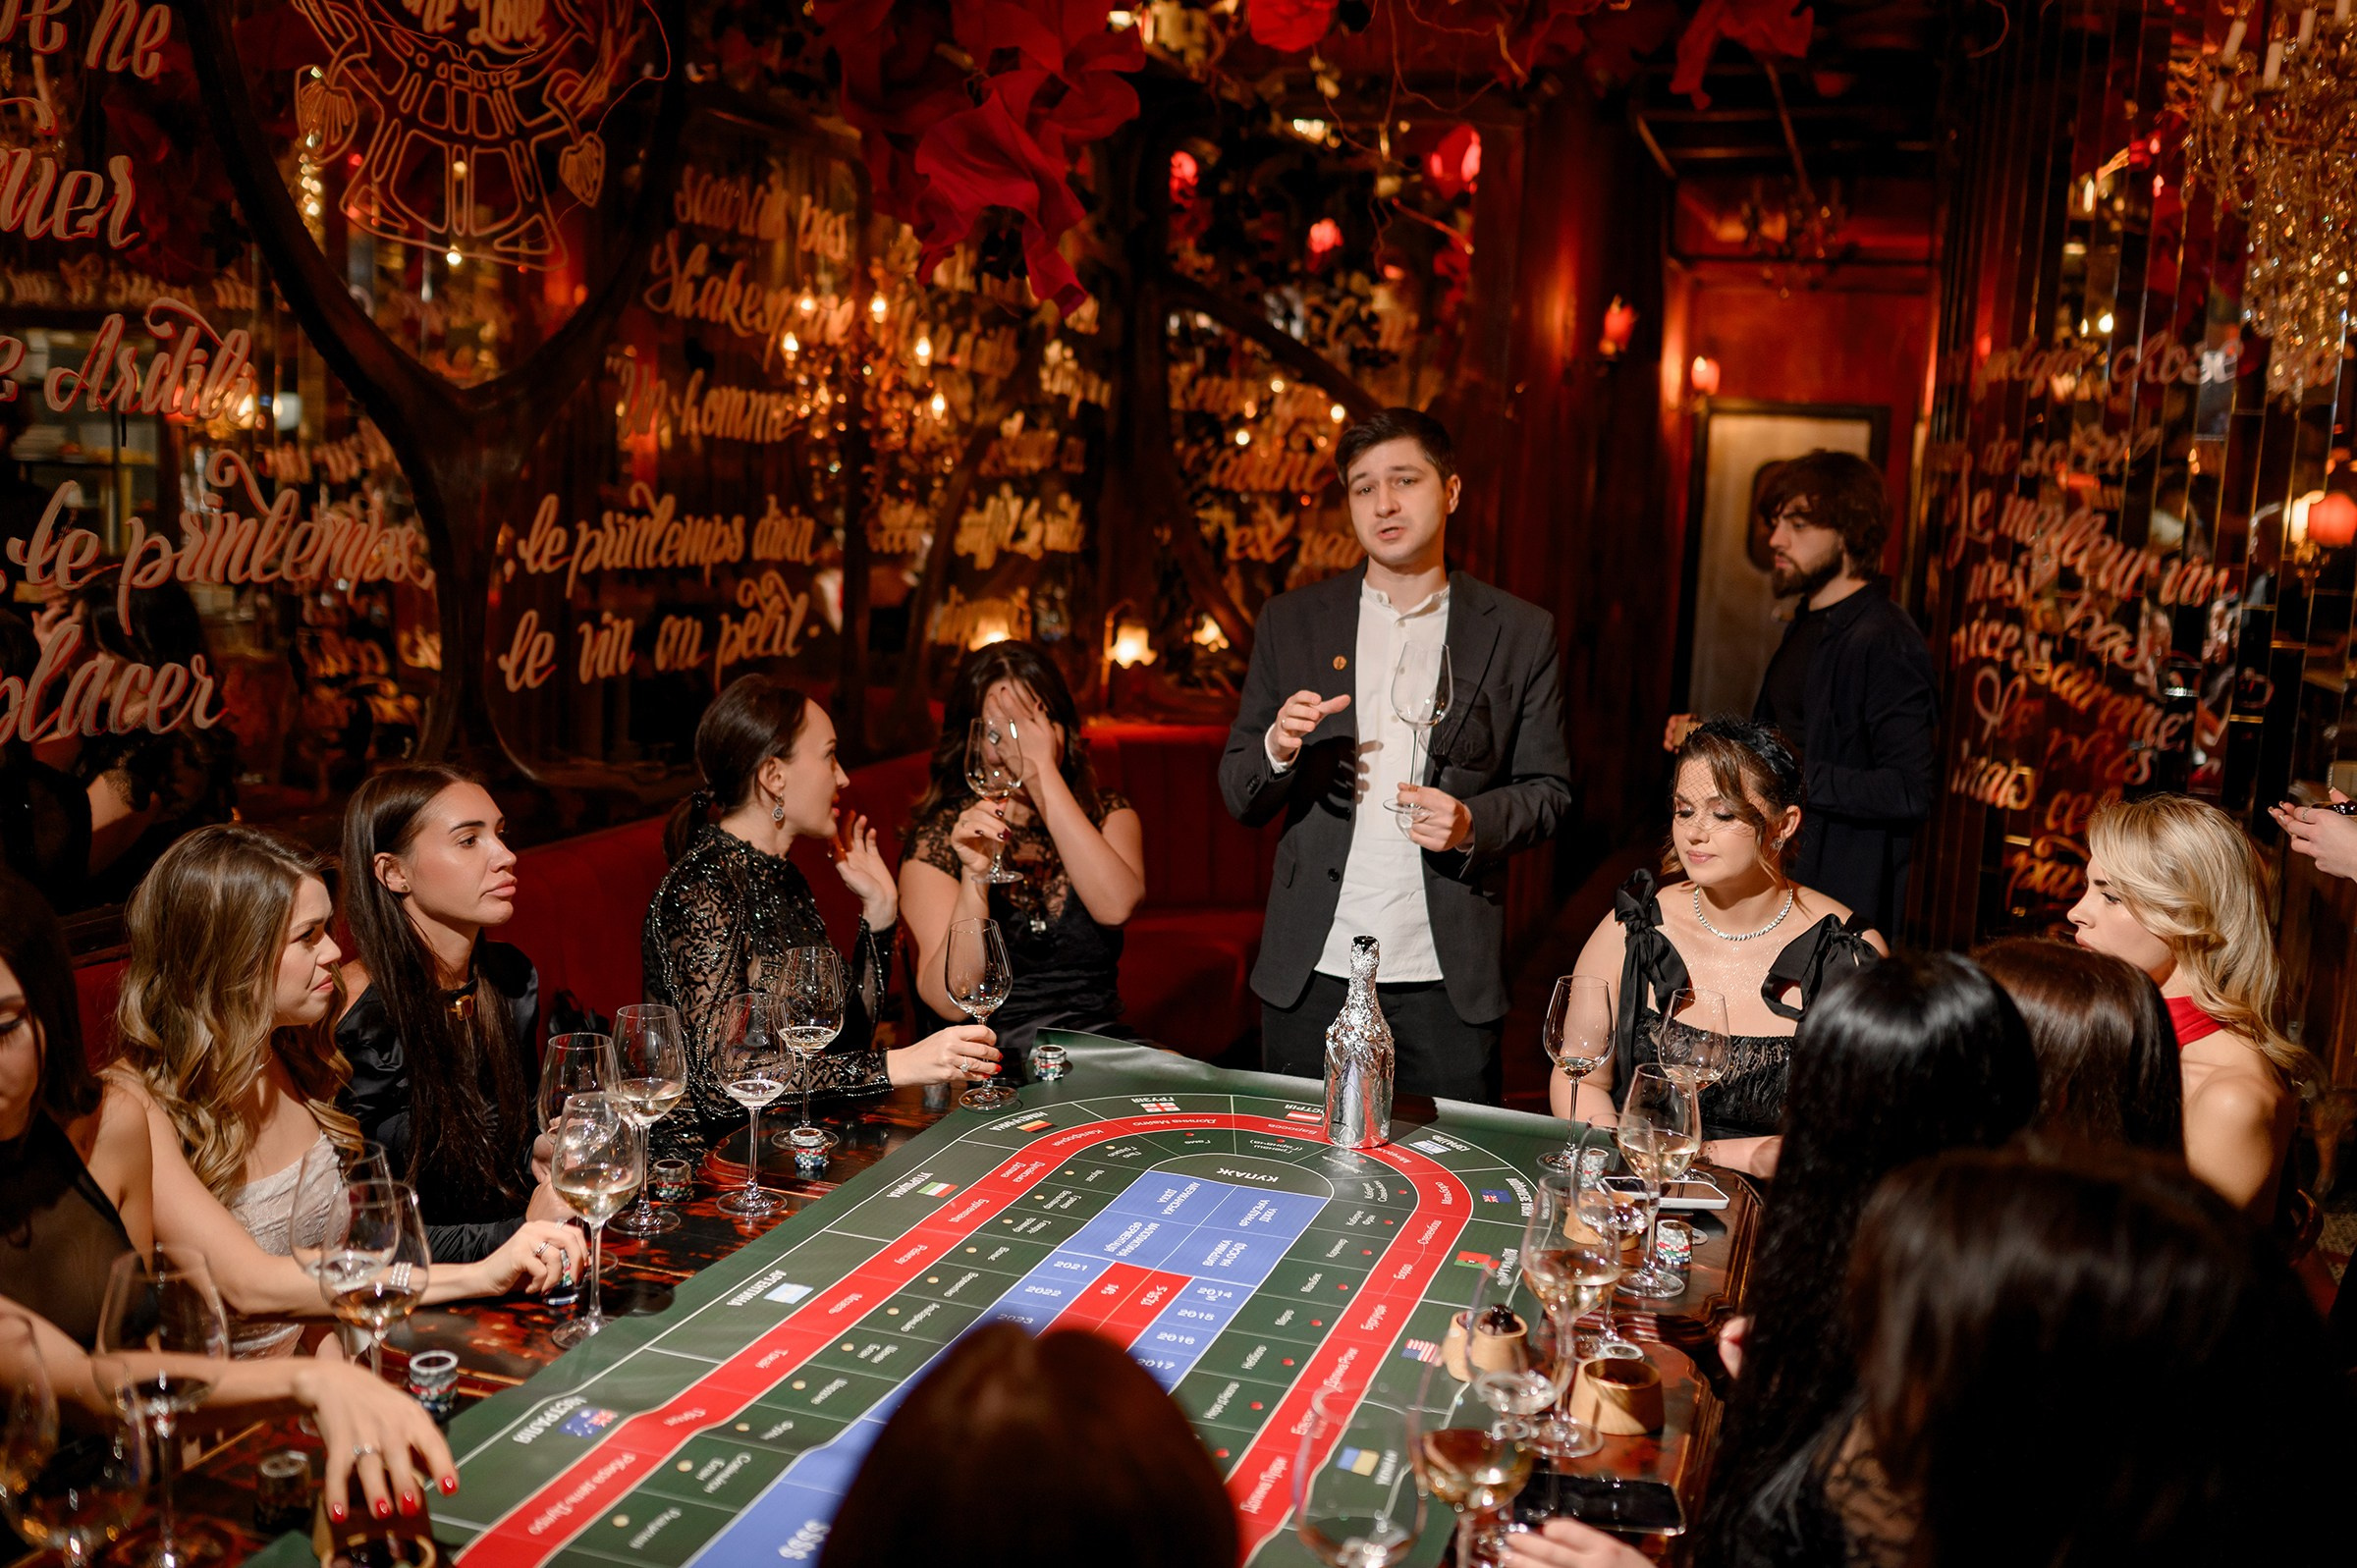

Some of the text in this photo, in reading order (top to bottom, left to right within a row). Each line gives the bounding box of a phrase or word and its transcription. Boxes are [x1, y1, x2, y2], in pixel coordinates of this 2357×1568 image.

[1130, 1096, 1175, 1105] ГРУЗІЯ
[1284, 1104, 1325, 1114] СТРІЯ
[989, 1110, 1049, 1132] НІМЕЧЧИНА
[1132, 1117, 1218, 1126] Долина Майпо
[1267, 1122, 1318, 1136] Баросса
[1000, 1162, 1027, 1179] Долина
[1216, 1167, 1280, 1183] КУПАЖ
[886, 1171, 934, 1199] УГОРЩИНА
[1160, 1181, 1201, 1216] АМЕРИКАНСЬКА
[1237, 1198, 1271, 1227] ФРАНЦУЗЬКА
[1103, 1220, 1144, 1253] ФЕРМЕНТАЦІЯ
[1201, 1239, 1233, 1268] ВИТРИМКА
[1053, 1260, 1088, 1271] 2021
[1393, 1263, 1415, 1280] Бордо
[726, 1269, 788, 1307] АРГЕНТИНА
[1024, 1284, 1063, 1298] 2022
[1196, 1286, 1233, 1300] 2014
[828, 1292, 864, 1316] Мозель
[1177, 1308, 1216, 1322] 2015
[1274, 1308, 1295, 1326] Мерло
[1156, 1330, 1196, 1345] 2016
[755, 1348, 790, 1370] Токай
[1136, 1357, 1177, 1371] 2017
